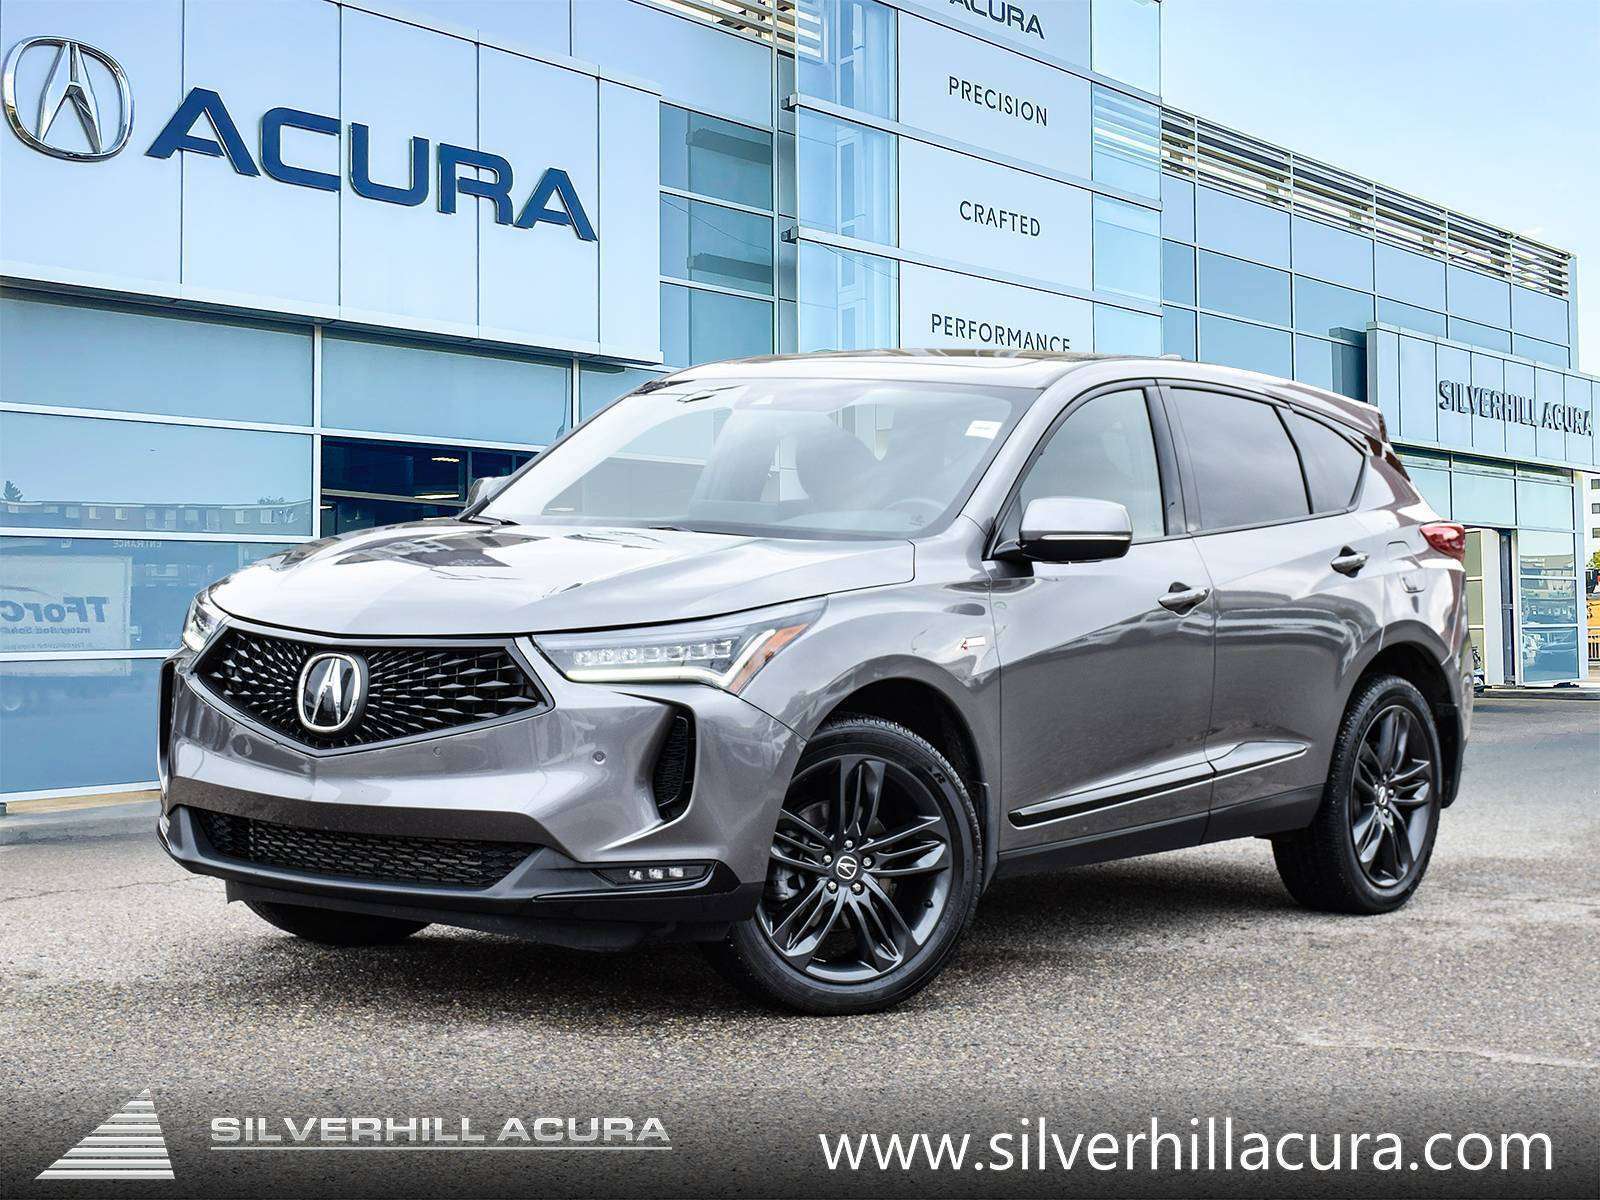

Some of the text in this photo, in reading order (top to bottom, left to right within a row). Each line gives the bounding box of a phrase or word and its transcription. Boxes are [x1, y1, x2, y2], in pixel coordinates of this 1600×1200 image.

[948, 75, 1048, 127] PRECISION
[145, 86, 598, 242] ACURA
[959, 200, 1041, 237] CRAFTED
[931, 313, 1070, 352] PERFORMANCE
[1438, 379, 1594, 437] SILVERHILL ACURA
